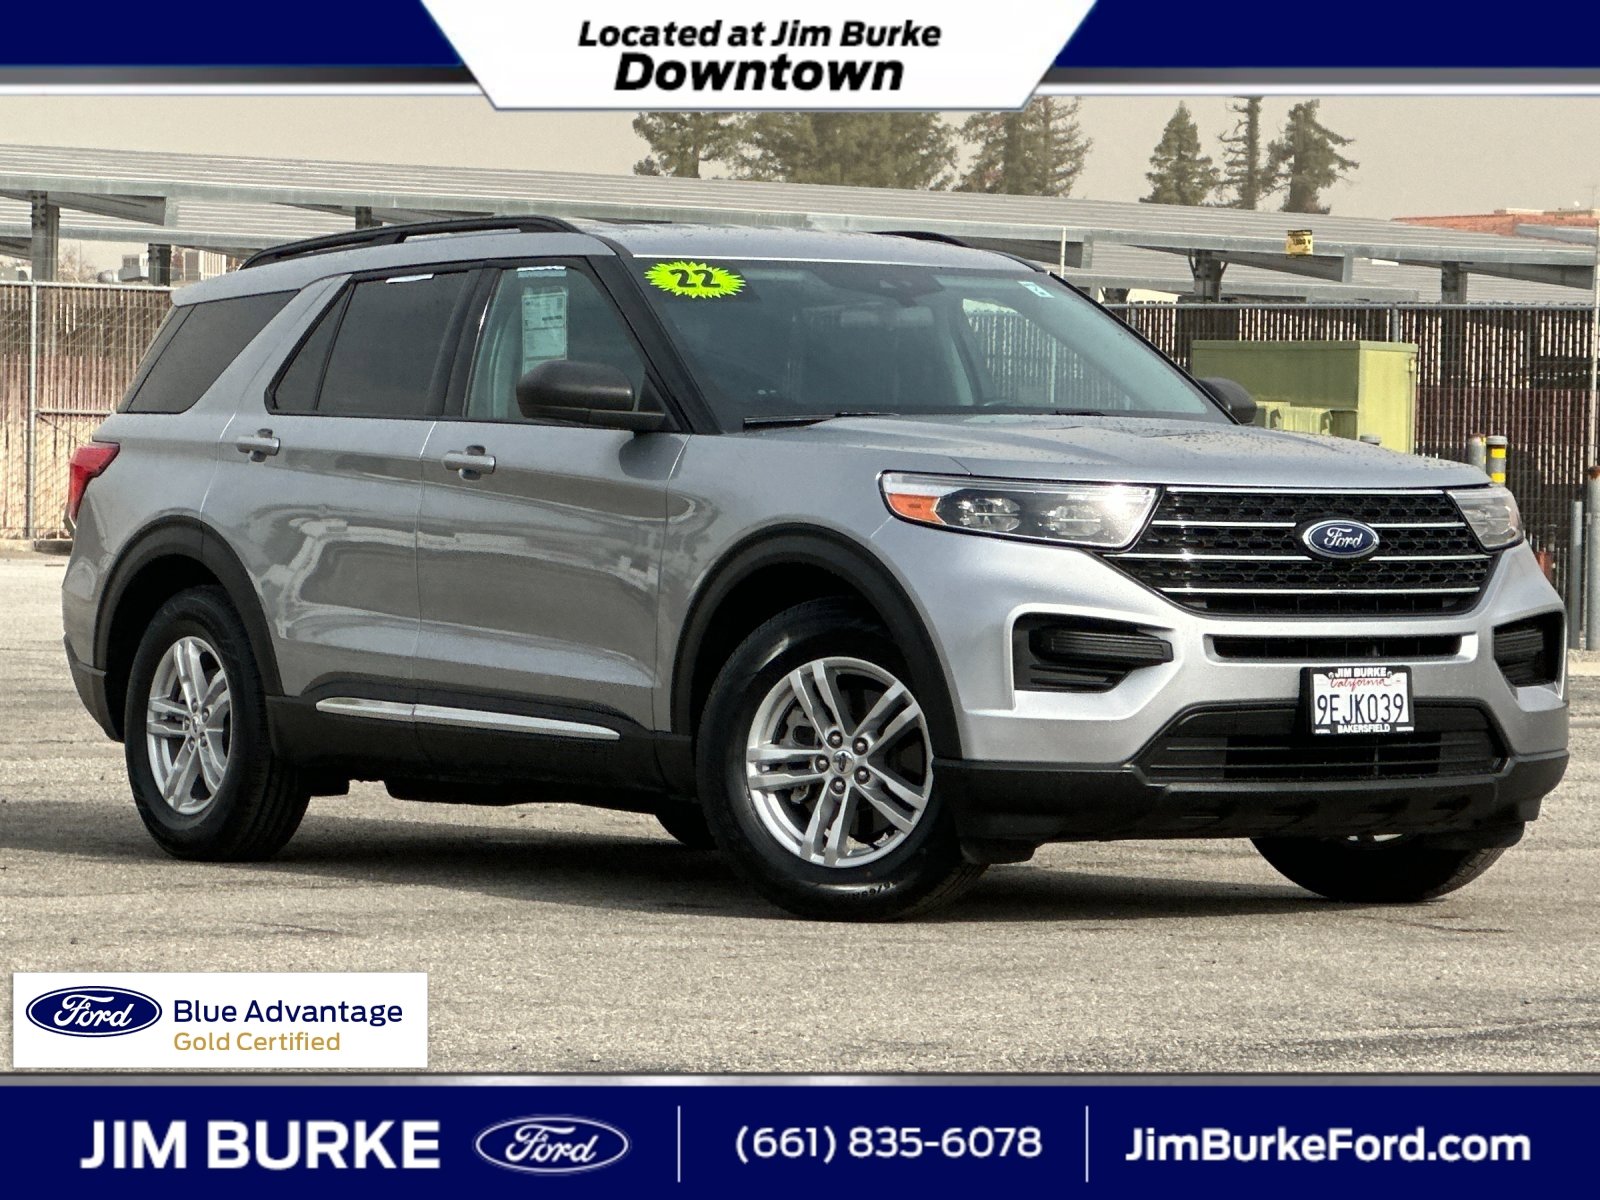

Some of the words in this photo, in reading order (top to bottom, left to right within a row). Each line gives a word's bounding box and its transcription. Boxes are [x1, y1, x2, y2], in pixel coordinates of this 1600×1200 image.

[669, 269, 721, 288] 22
[1324, 526, 1363, 548] Ford
[1335, 668, 1351, 678] JIM
[1353, 667, 1387, 677] BURKE
[1330, 678, 1392, 692] California
[1317, 693, 1404, 724] 9EJK039
[1337, 724, 1391, 734] BAKERSFIELD
